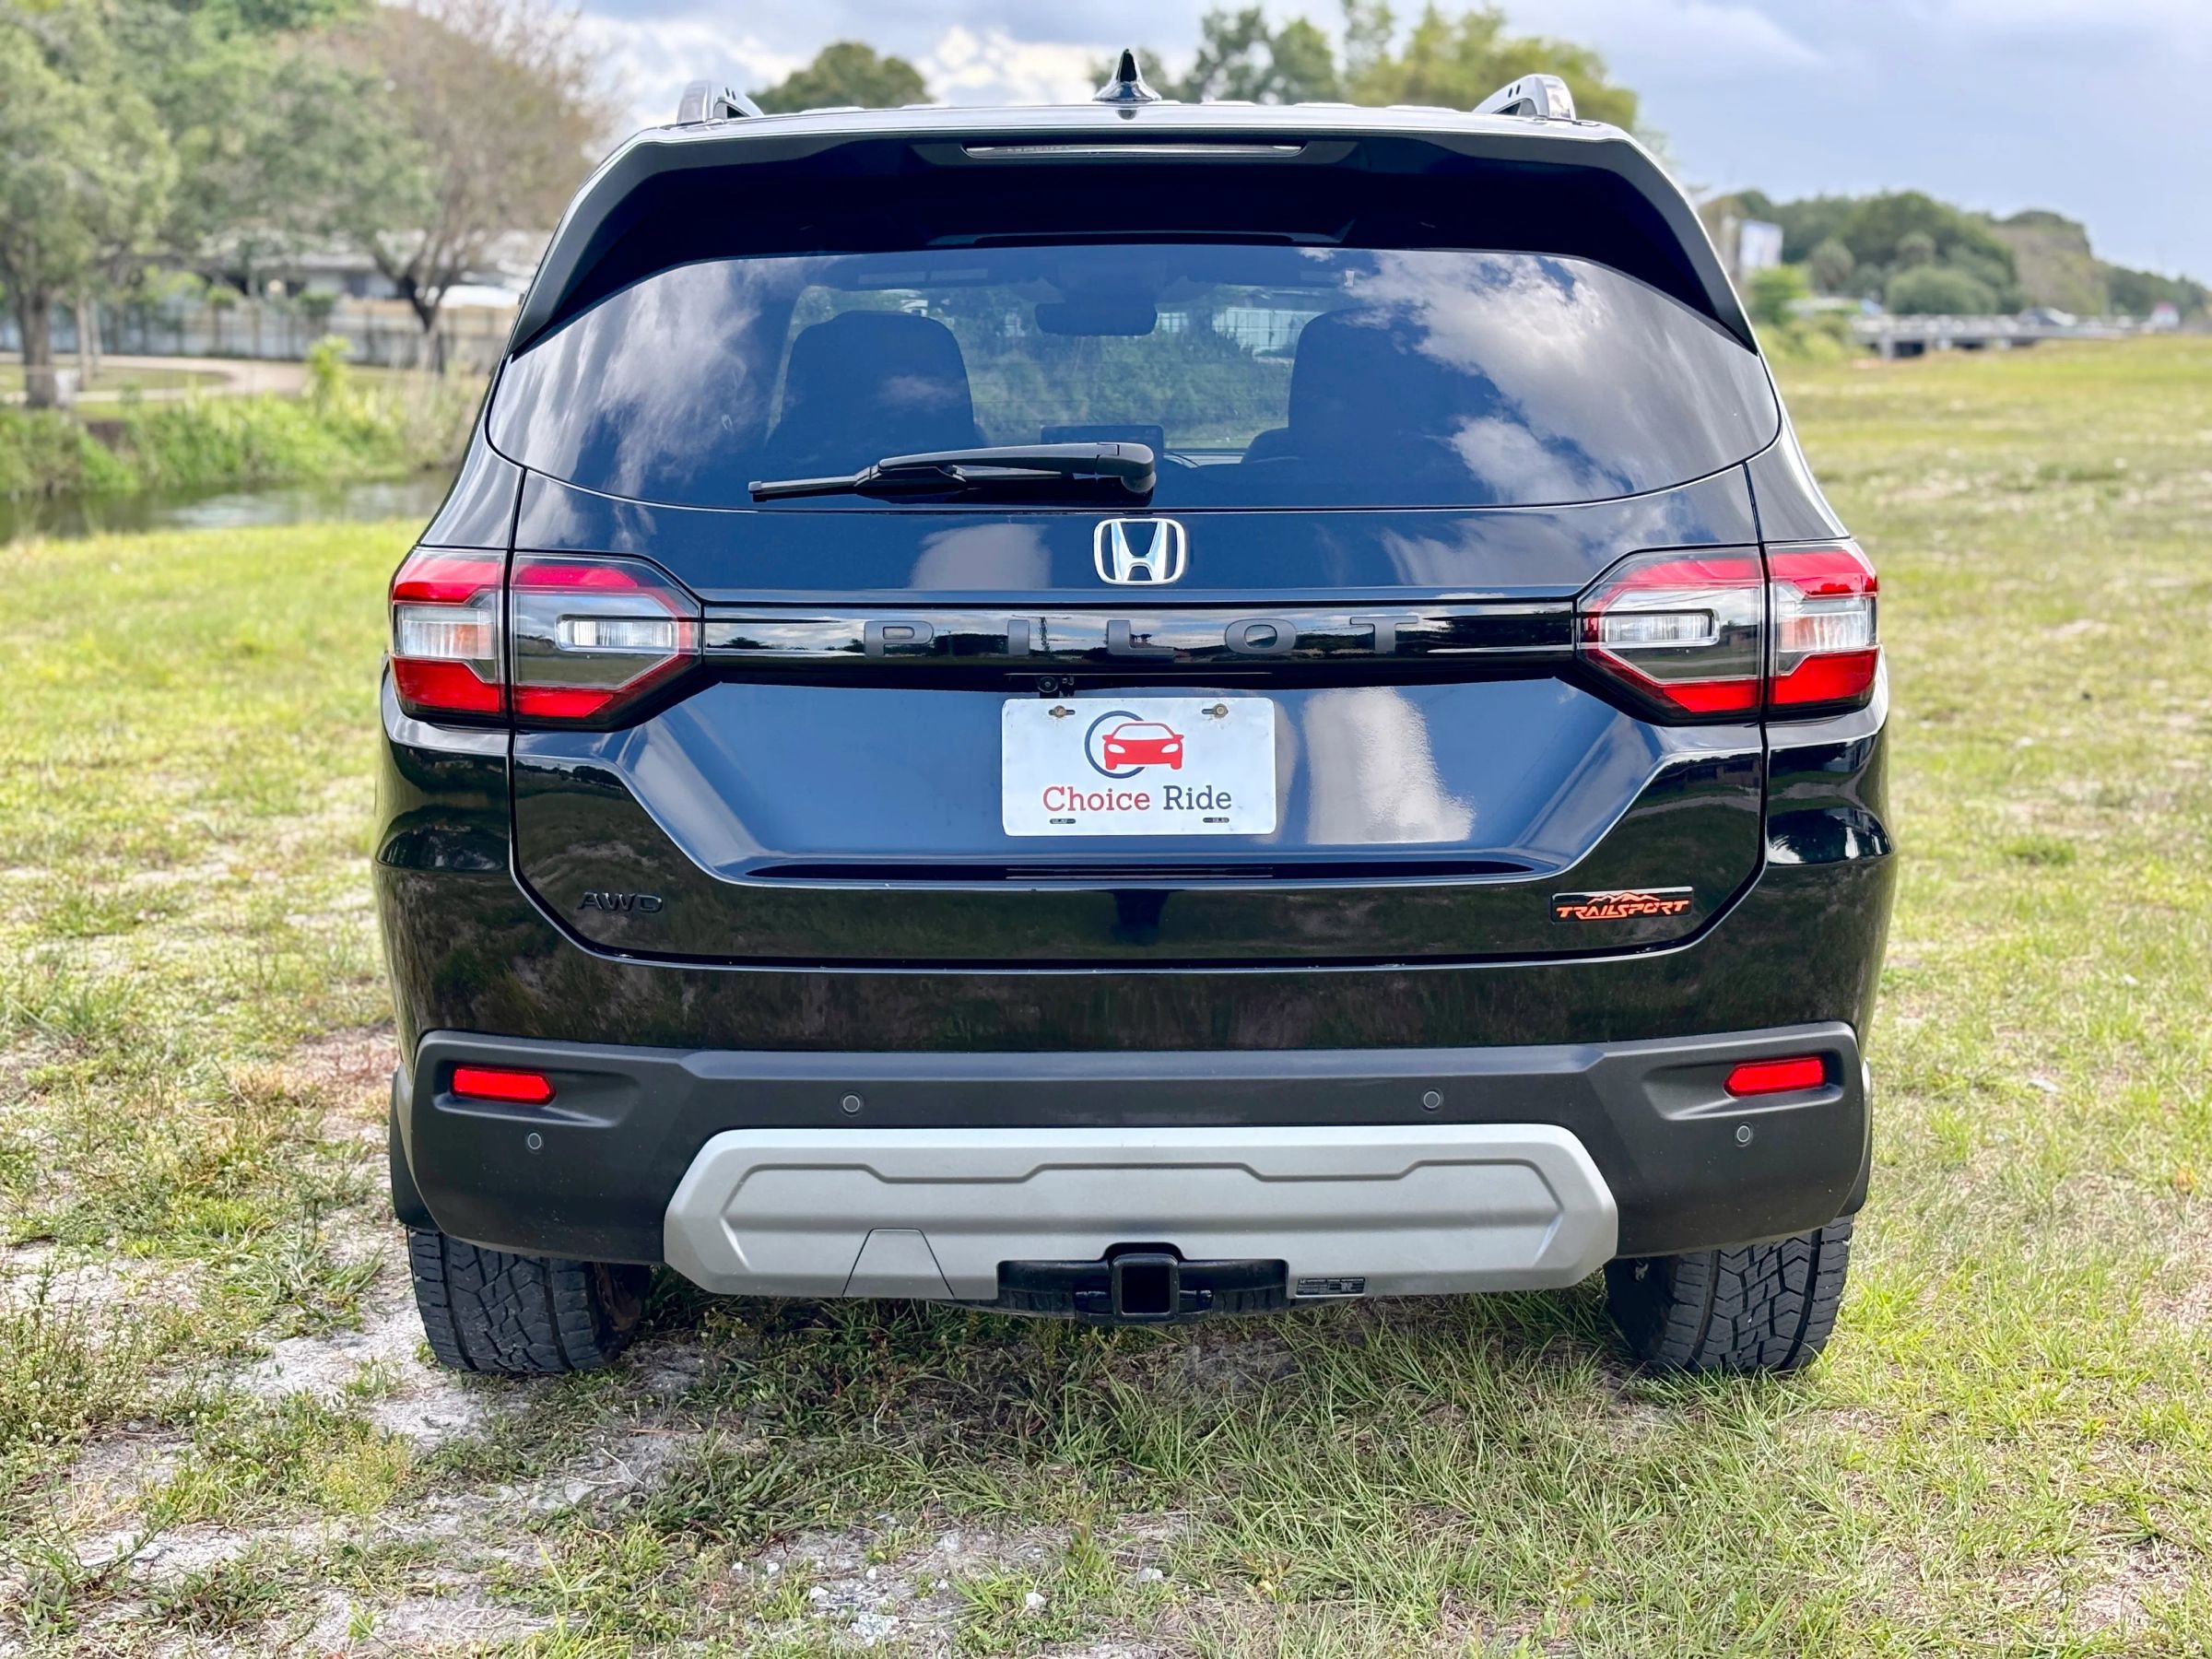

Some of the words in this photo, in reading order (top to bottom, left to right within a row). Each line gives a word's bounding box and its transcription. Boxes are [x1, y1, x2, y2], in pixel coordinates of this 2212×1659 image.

[864, 616, 1418, 657] PILOT
[1042, 785, 1151, 812] Choice
[1163, 785, 1232, 811] Ride
[578, 891, 664, 913] AWD
[1556, 900, 1689, 920] TRAILSPORT
